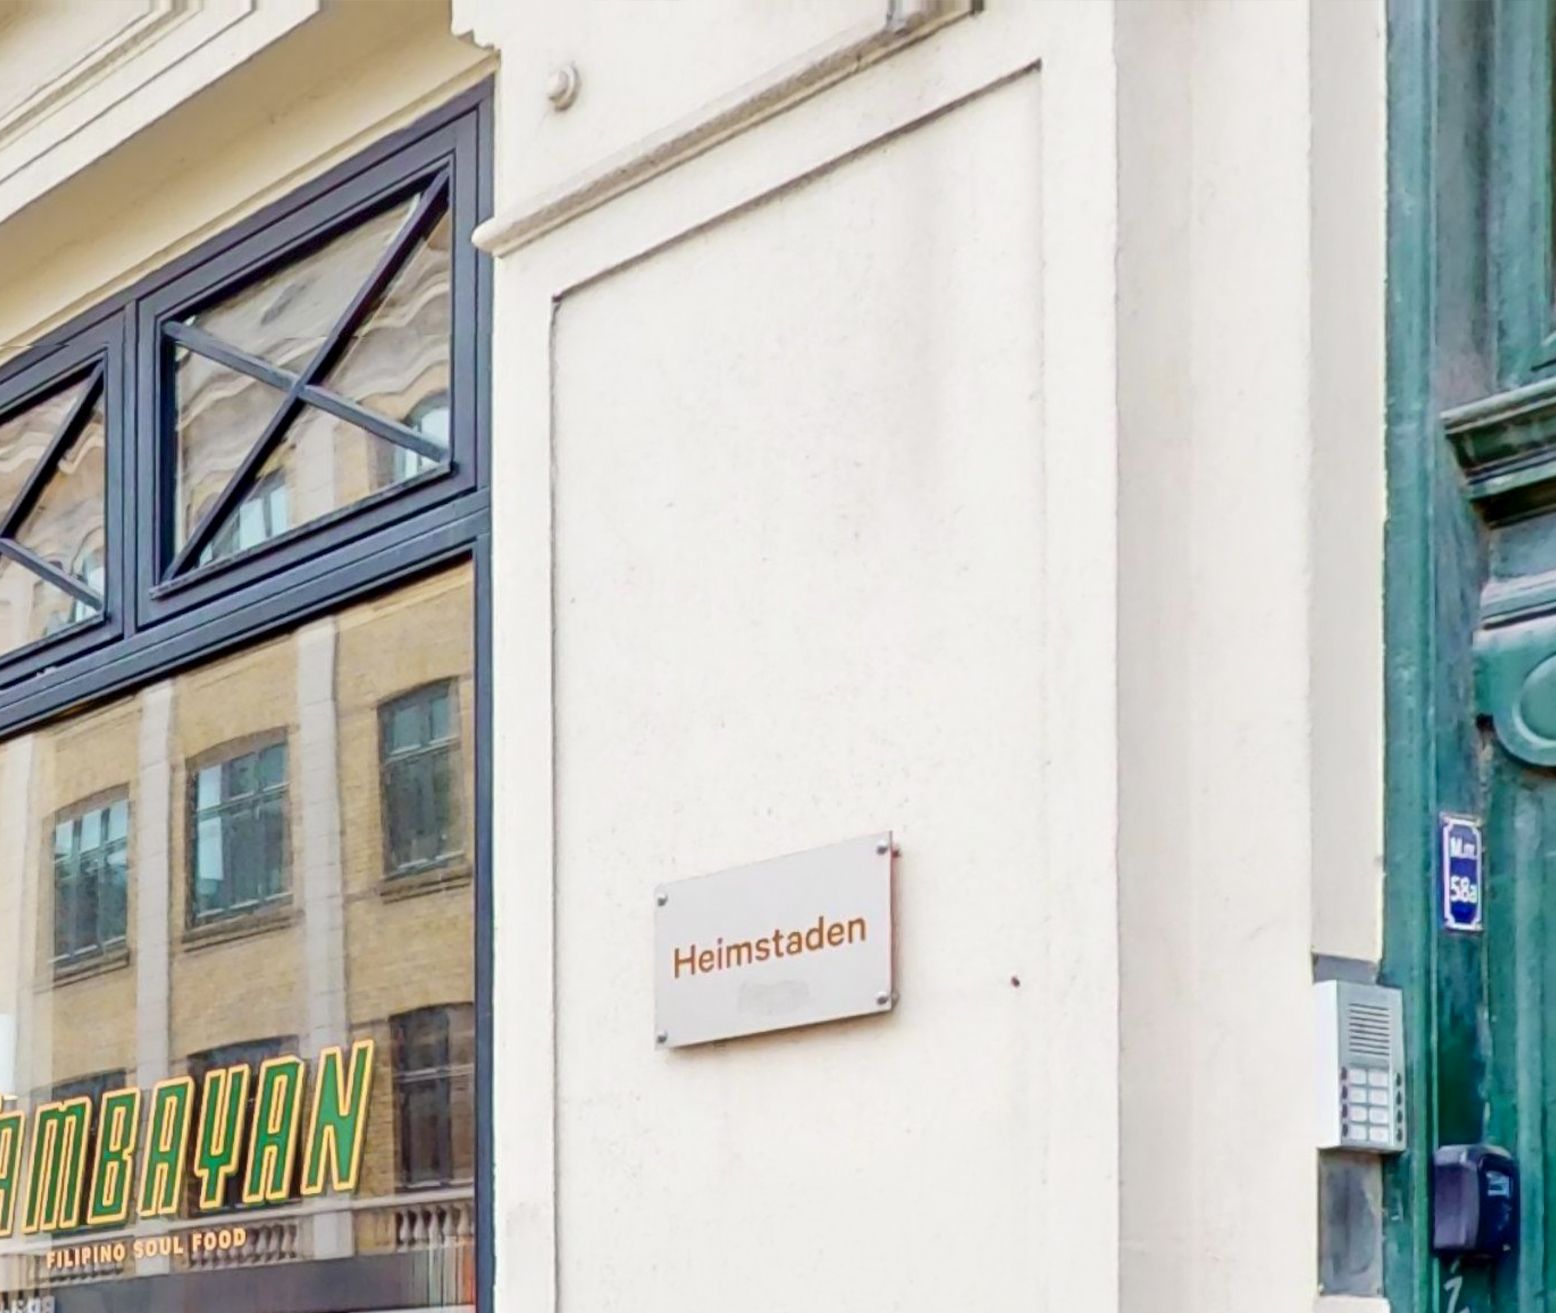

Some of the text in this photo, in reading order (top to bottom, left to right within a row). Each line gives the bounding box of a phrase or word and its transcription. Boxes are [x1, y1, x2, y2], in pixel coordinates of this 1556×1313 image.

[673, 915, 867, 979] Heimstaden
[46, 1227, 247, 1270] FILIPINO SOUL FOOD
